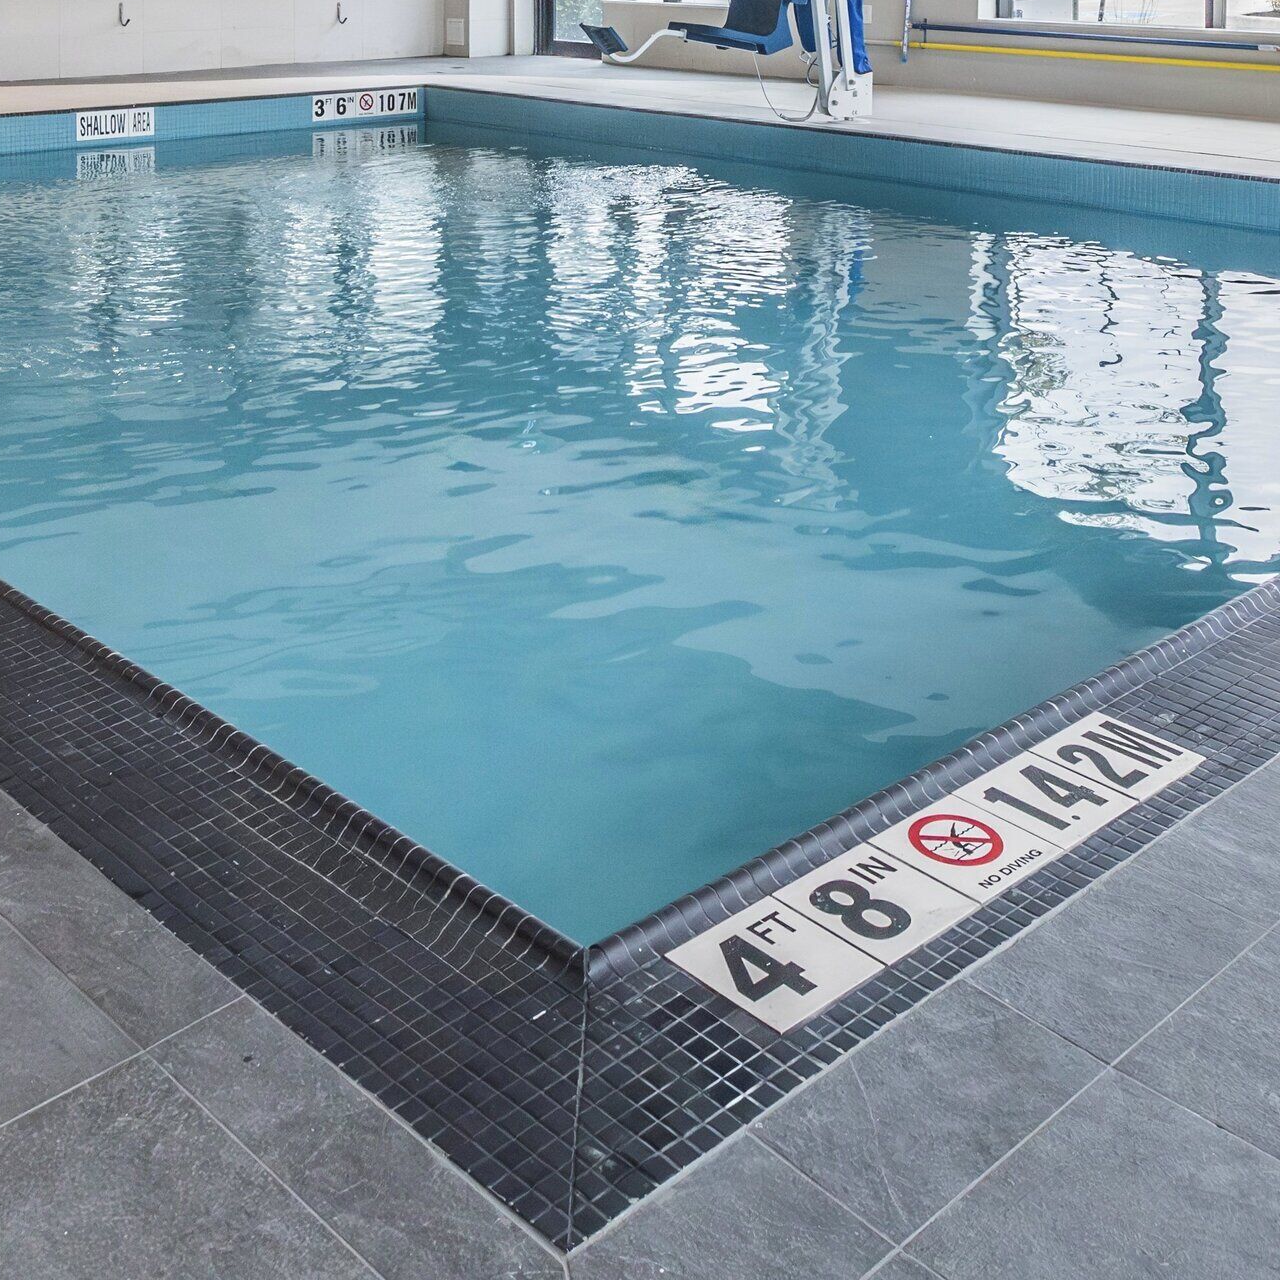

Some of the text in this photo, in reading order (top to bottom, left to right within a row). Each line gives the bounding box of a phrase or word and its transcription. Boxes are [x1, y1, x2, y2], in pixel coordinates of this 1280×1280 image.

[80, 111, 151, 137] SHALLOW AREA
[978, 849, 1043, 890] NO DIVING
